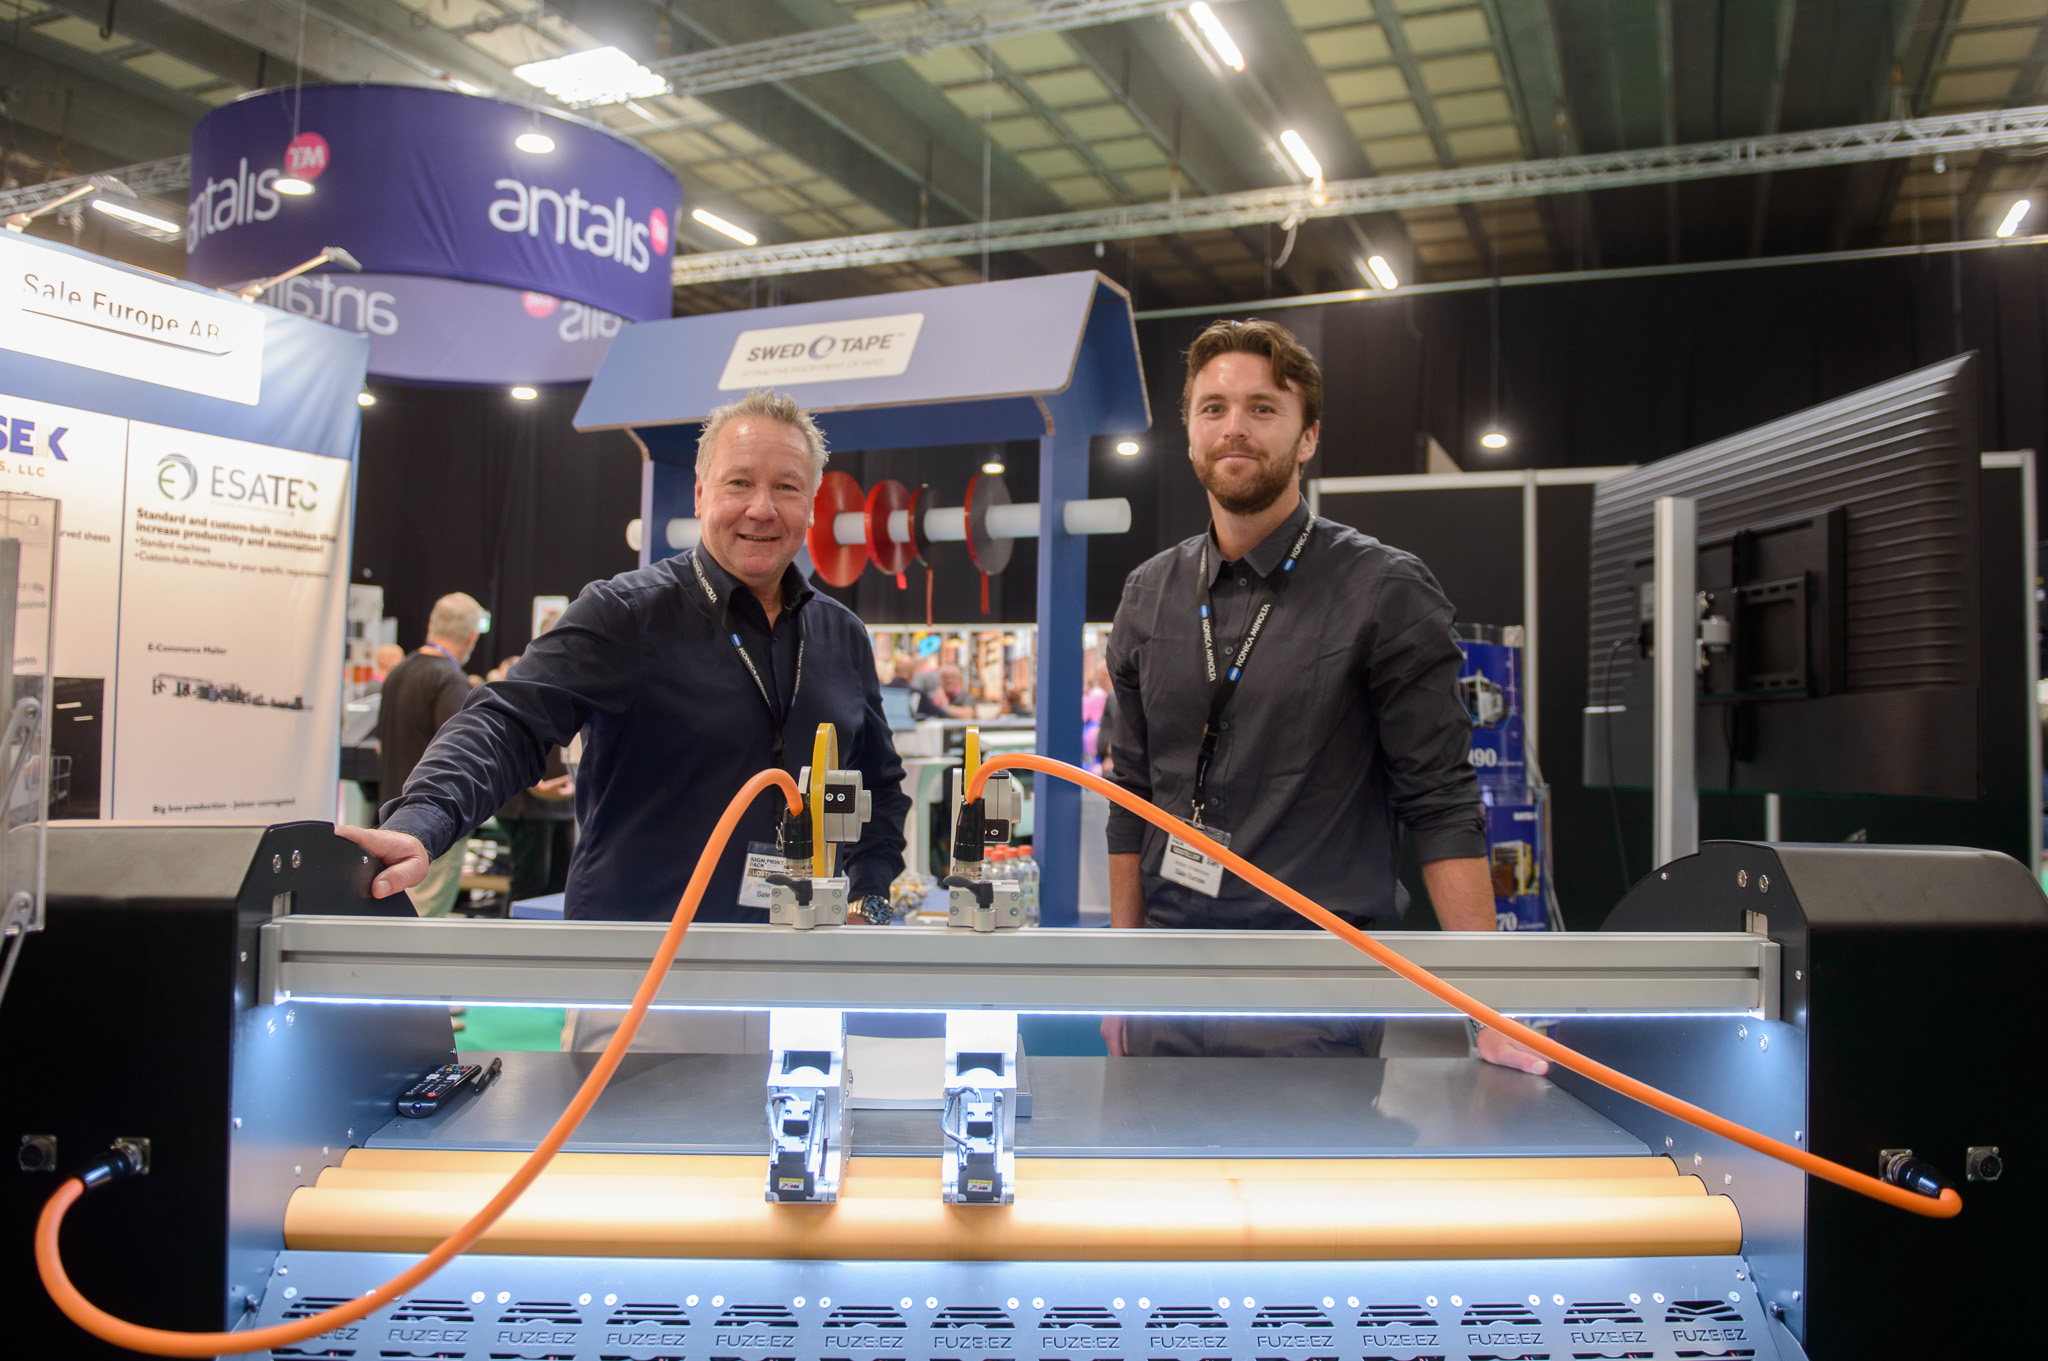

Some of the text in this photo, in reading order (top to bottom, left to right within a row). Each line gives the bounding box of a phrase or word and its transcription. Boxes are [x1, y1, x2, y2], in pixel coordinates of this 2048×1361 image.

[186, 157, 281, 255] antalis
[489, 178, 650, 274] antalis
[23, 273, 82, 304] Sale
[92, 290, 179, 333] Europe
[747, 342, 805, 362] SWED
[841, 333, 895, 353] TAPE
[18, 464, 45, 477] LLC
[211, 466, 318, 512] ESATEC
[84, 531, 111, 543] sheets
[136, 522, 180, 537] increase
[184, 529, 244, 546] productivity
[247, 537, 264, 548] and
[137, 507, 186, 524] Standard
[189, 516, 208, 528] and
[210, 519, 271, 536] custom-built
[274, 528, 317, 542] machines
[140, 537, 211, 554] Standard machines
[1290, 531, 1309, 559] KONICA
[1235, 603, 1271, 667] KONICA MINOLTA
[739, 647, 757, 675] KONICA
[1202, 618, 1217, 682] KONICA MINOLTA
[153, 804, 166, 815] Big
[757, 890, 770, 898] Sale
